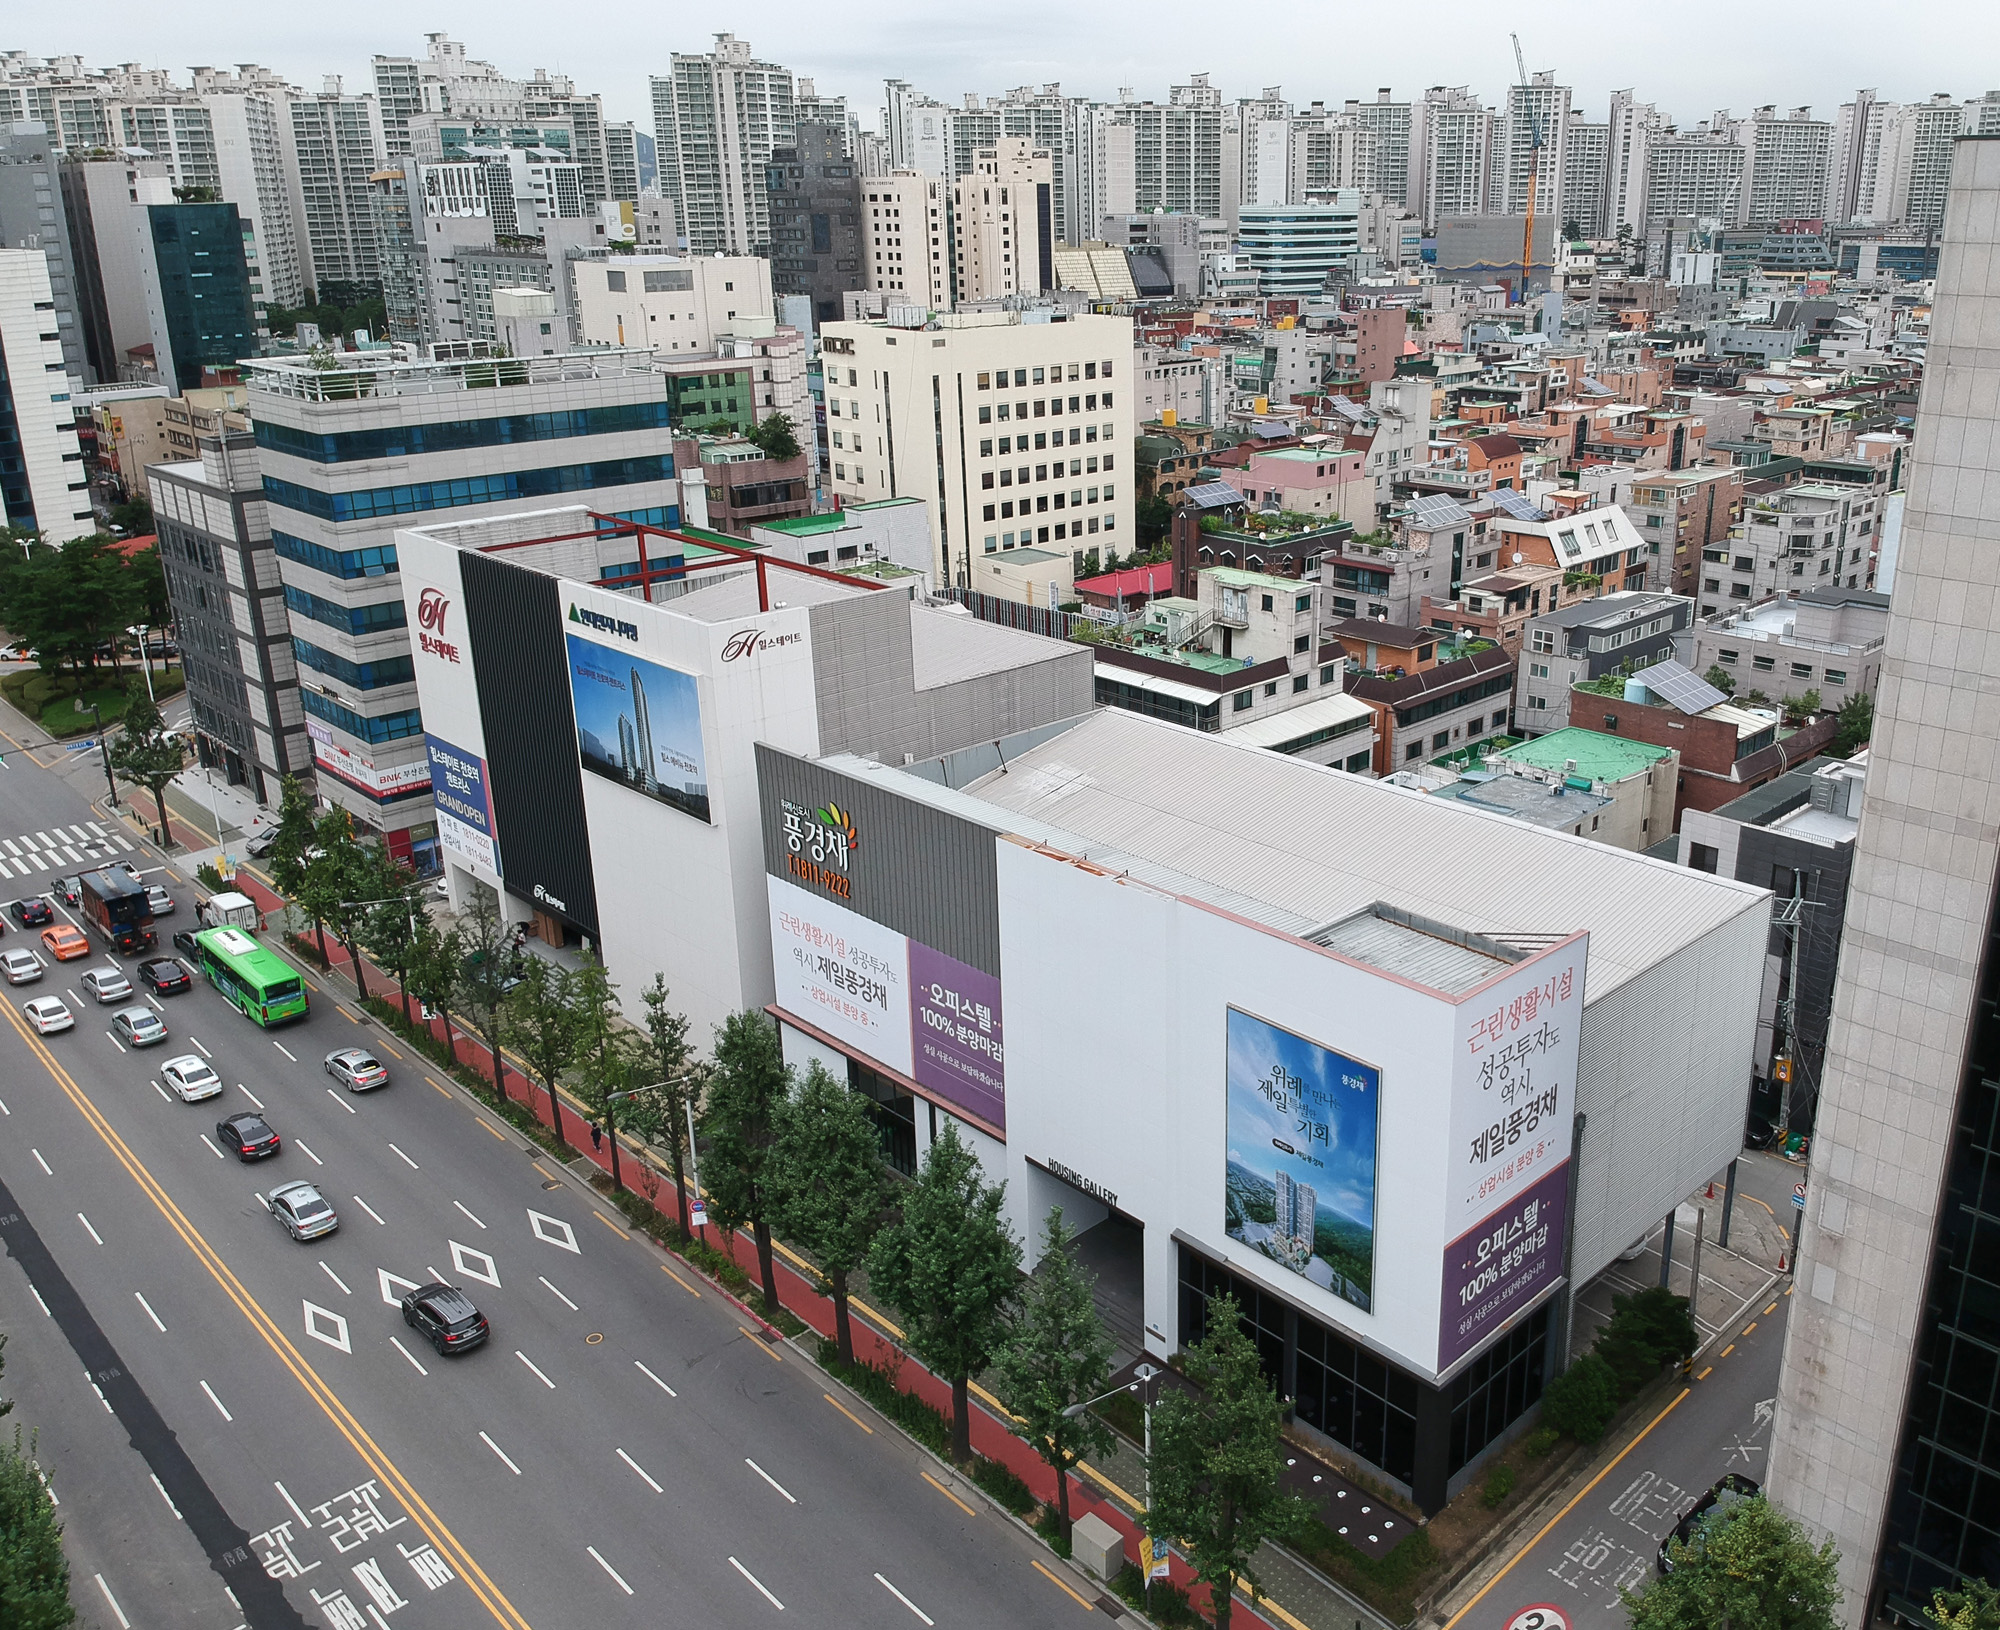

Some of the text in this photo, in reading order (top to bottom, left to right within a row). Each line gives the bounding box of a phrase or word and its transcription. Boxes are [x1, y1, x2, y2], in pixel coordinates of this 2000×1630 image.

[579, 608, 638, 642] 현대엔지니어링
[758, 632, 802, 650] 힐스테이트
[419, 632, 460, 664] 힐스테이트
[380, 772, 402, 784] BNK
[430, 746, 480, 784] 힐스테이트 천호역
[436, 789, 486, 827] GRAND OPEN
[440, 815, 459, 833] 아파트
[781, 799, 811, 819] 위례신도시
[783, 812, 849, 871] 풍경채
[787, 853, 850, 899] T.1811-9222
[779, 911, 898, 984] 근린생활시설 성공투자도
[817, 955, 887, 1011] 제일풍경채
[811, 985, 869, 1026] 상업시설 분양 중
[930, 983, 991, 1034] 오피스텔
[1467, 966, 1573, 1054] 근린생활시설
[920, 1006, 1003, 1063] 100% 분양마감
[1476, 1021, 1560, 1090] 성공투자도
[961, 1063, 1003, 1093] 보답하겠습니다
[1341, 1074, 1365, 1093] 풍경채
[1501, 1068, 1534, 1106] 역시,
[1257, 1079, 1317, 1119] 제일 특별한
[1312, 1090, 1343, 1111] 만나는
[1297, 1119, 1329, 1147] 기회
[1469, 1083, 1558, 1164] 제일풍경채
[1048, 1157, 1118, 1207] HOUSING GALLERY
[1478, 1141, 1545, 1199] 상업시설 분양 중
[1474, 1199, 1539, 1268] 오피스텔
[1459, 1223, 1548, 1306] 100% 분양마감
[1500, 1259, 1546, 1302] 보답하겠습니다
